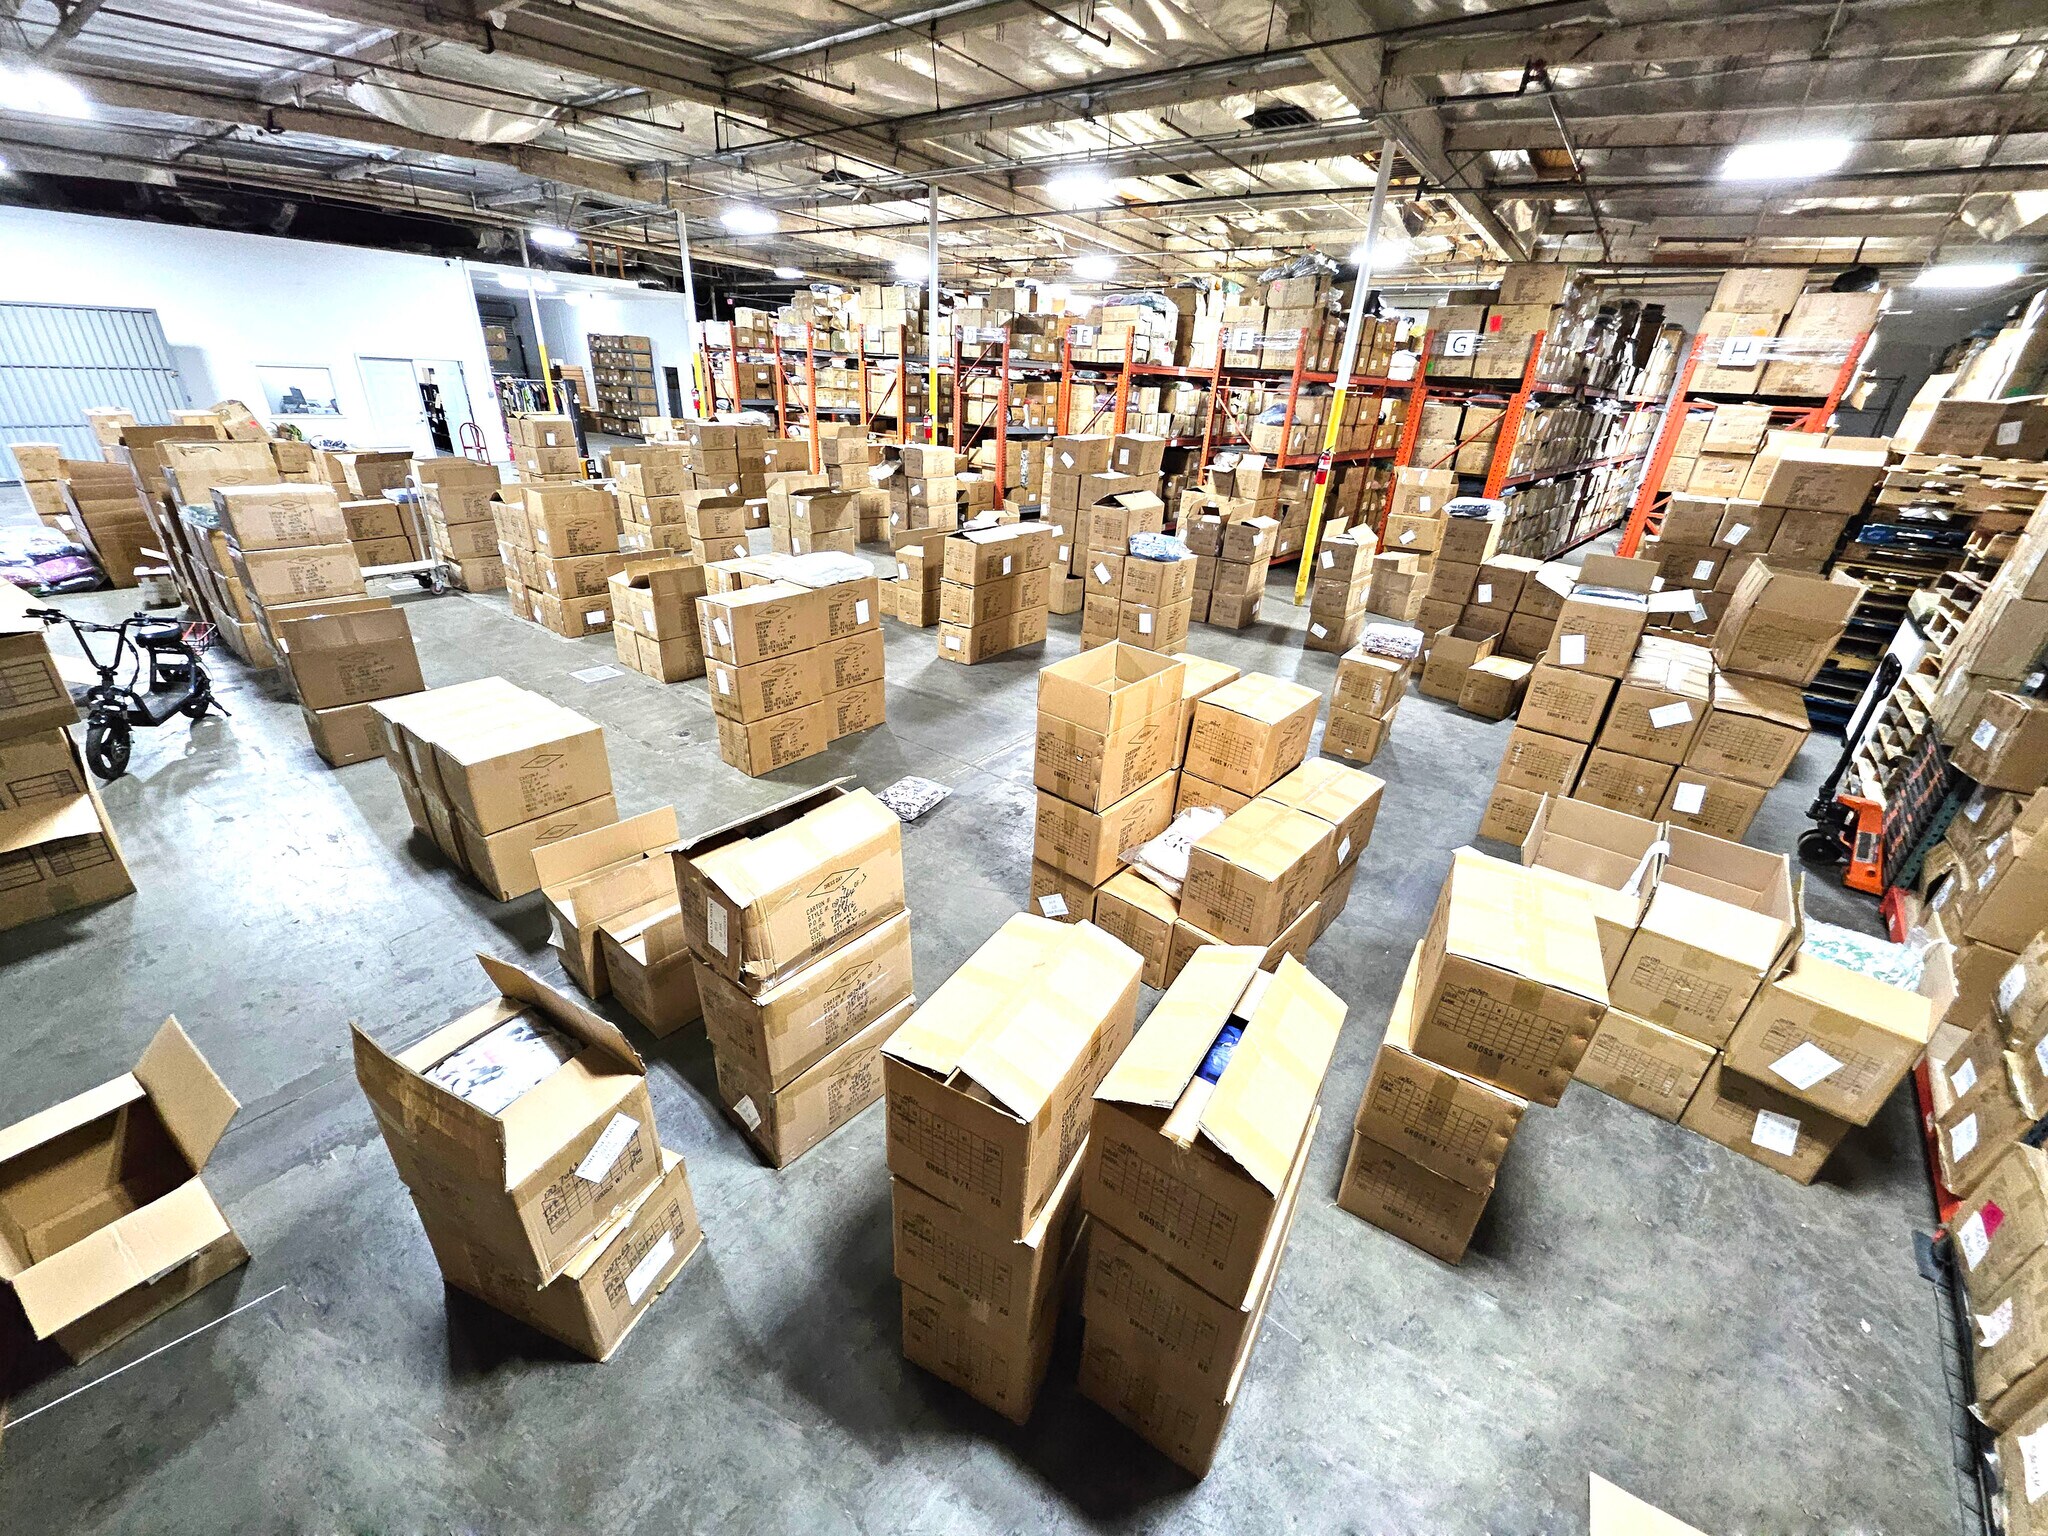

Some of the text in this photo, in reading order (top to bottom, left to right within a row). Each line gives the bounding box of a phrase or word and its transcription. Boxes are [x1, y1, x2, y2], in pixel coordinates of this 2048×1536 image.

[1082, 329, 1088, 343] E
[1240, 332, 1248, 347] F
[1453, 336, 1467, 354] G
[1731, 340, 1752, 355] H
[806, 901, 825, 916] CARTON
[807, 909, 823, 920] STYLE
[822, 994, 840, 1009] CARTON
[1467, 1041, 1494, 1057] GROSS
[1537, 1068, 1550, 1078] KG
[1403, 1126, 1428, 1142] GROSS
[925, 1160, 950, 1179] GROSS
[990, 1196, 1001, 1208] KG
[1138, 1210, 1166, 1233] GROSS
[1212, 1259, 1224, 1271] KG
[938, 1272, 960, 1290] GROSS
[1129, 1318, 1155, 1337] GROSS
